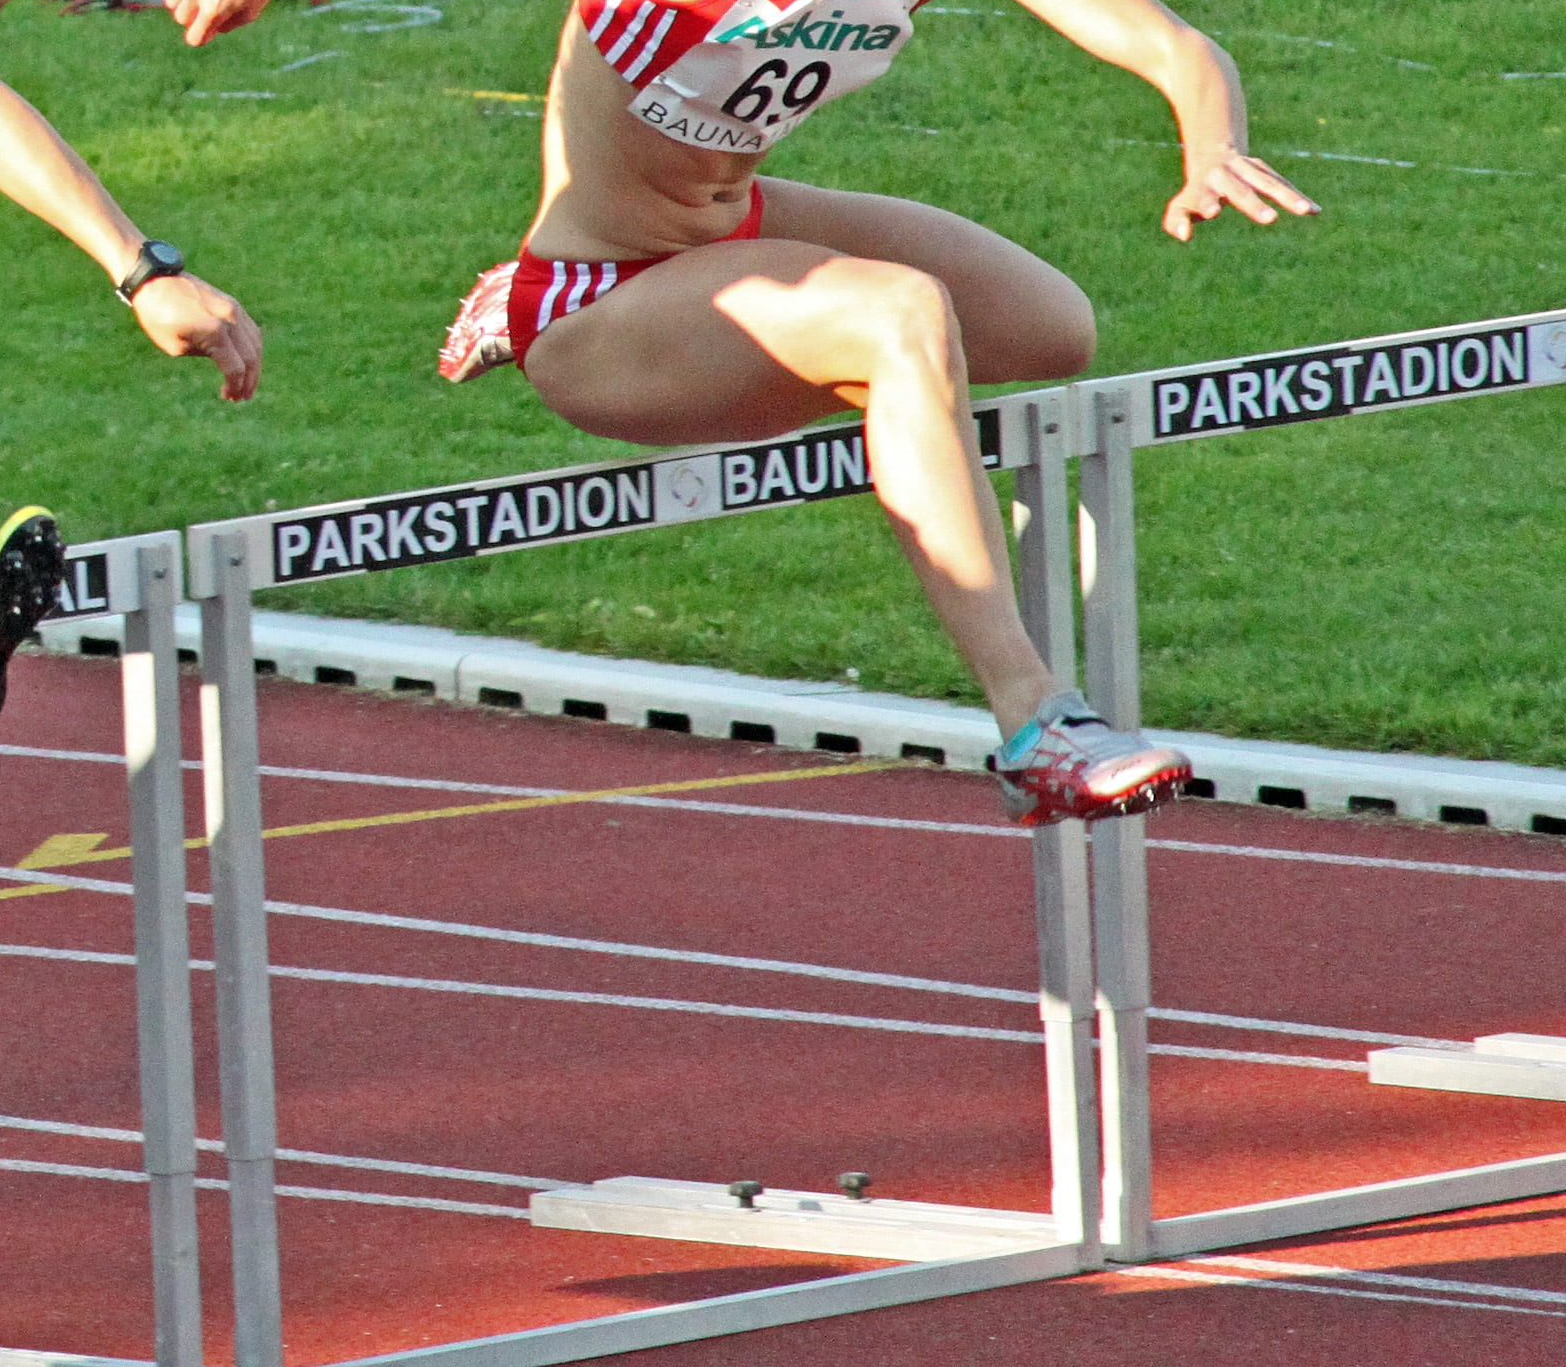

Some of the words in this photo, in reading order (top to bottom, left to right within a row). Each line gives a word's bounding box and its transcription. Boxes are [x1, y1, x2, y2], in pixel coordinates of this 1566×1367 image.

[714, 10, 900, 51] Askina
[722, 58, 832, 126] 69
[1158, 332, 1525, 433] PARKSTADION
[278, 469, 651, 577] PARKSTADION
